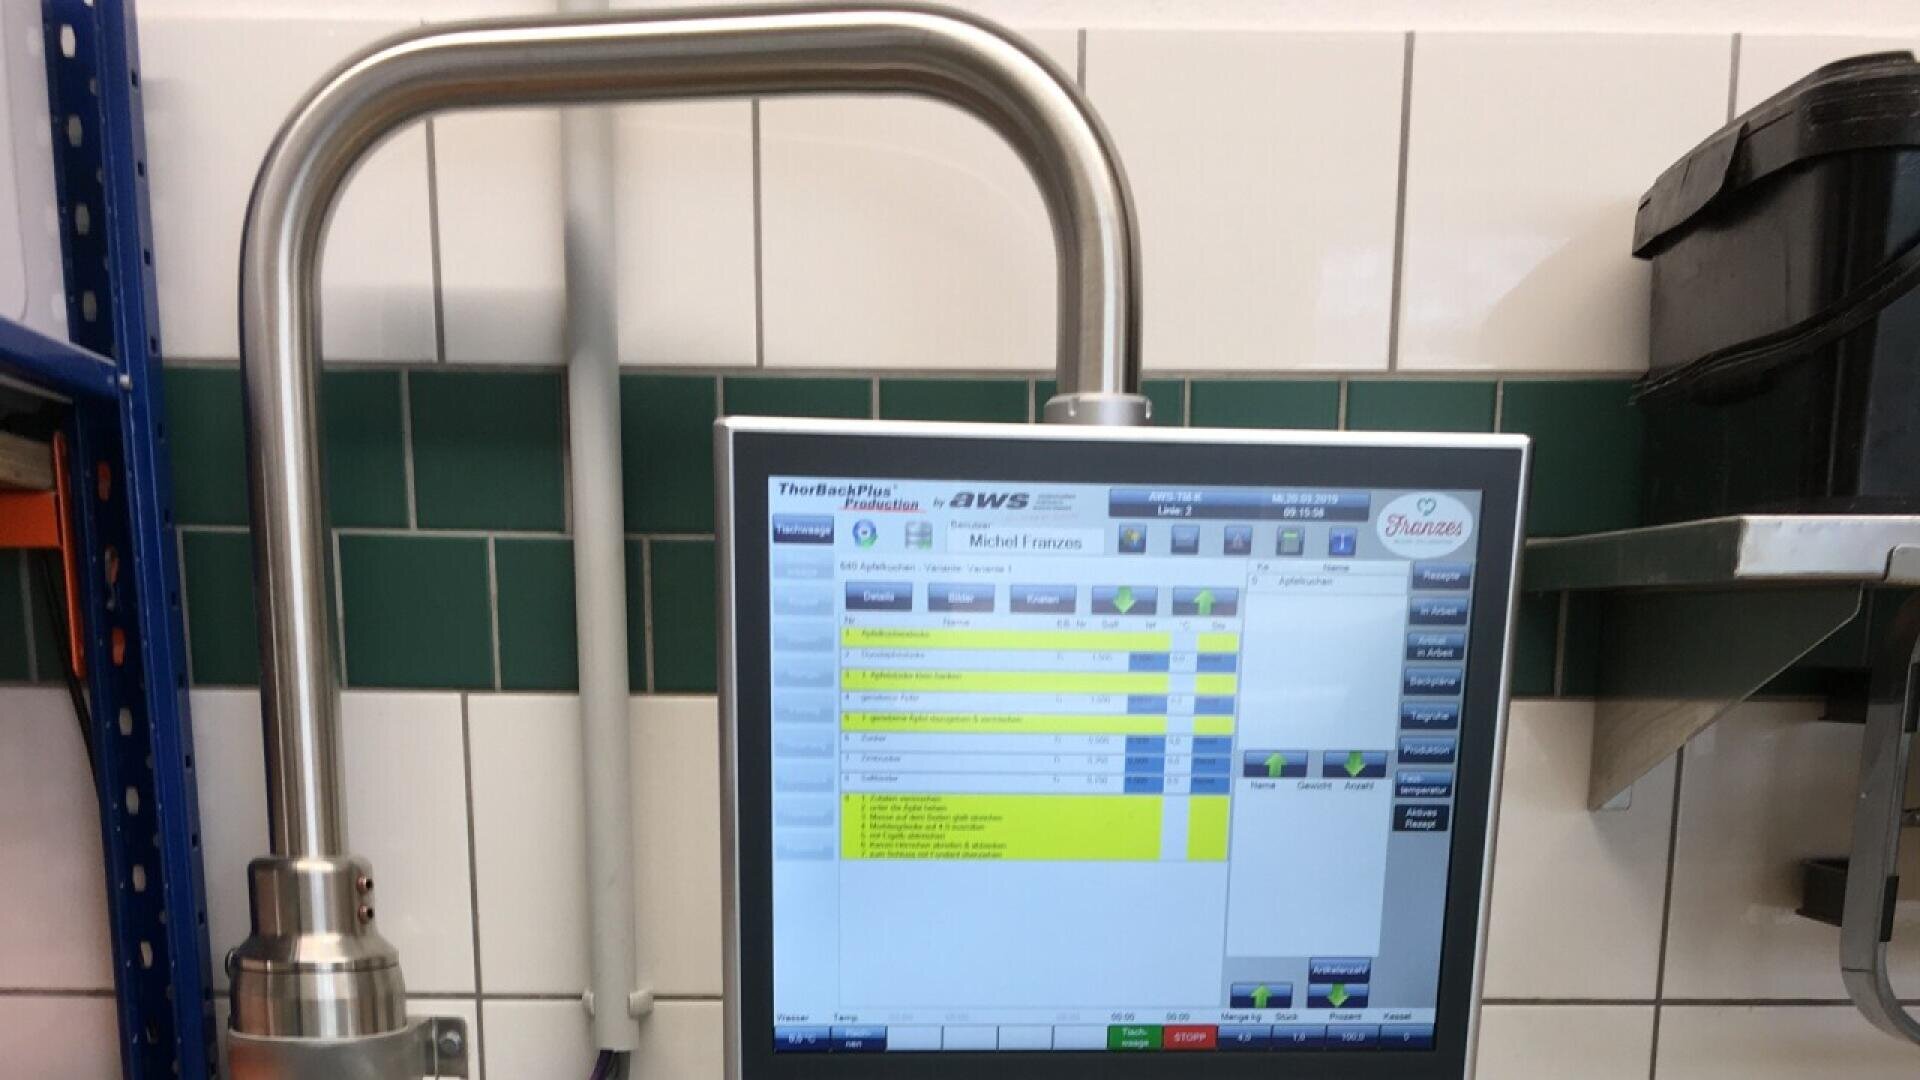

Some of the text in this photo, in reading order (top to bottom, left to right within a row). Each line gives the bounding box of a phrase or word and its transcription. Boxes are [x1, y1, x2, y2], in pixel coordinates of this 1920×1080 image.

[779, 482, 892, 497] ThorBackPlus
[844, 498, 919, 512] Production
[933, 497, 945, 511] by
[949, 491, 1030, 510] aws
[1185, 504, 1193, 516] 2
[1386, 514, 1462, 537] Franzes
[969, 533, 1083, 550] Michel Franzes
[1174, 1031, 1207, 1042] STOPP
